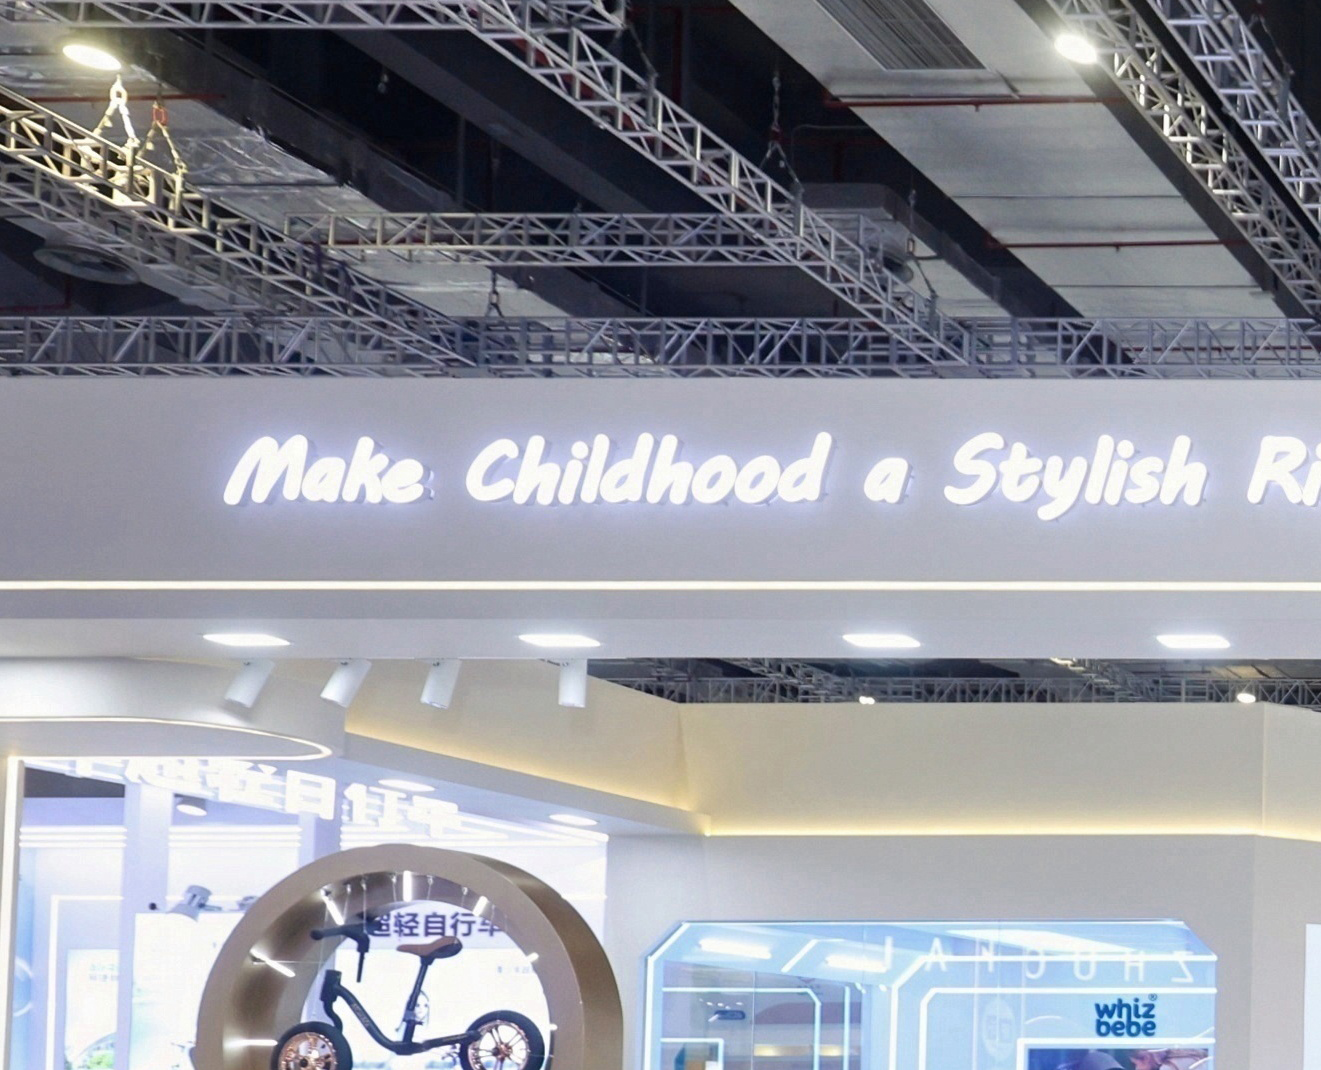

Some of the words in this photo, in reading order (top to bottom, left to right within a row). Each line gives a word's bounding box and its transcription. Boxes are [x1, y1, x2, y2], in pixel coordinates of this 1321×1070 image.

[223, 434, 424, 506] Make
[465, 432, 833, 506] Childhood
[863, 456, 909, 504] a
[944, 432, 1208, 522] Stylish
[1094, 997, 1156, 1018] whiz
[1095, 1017, 1157, 1038] bebe
